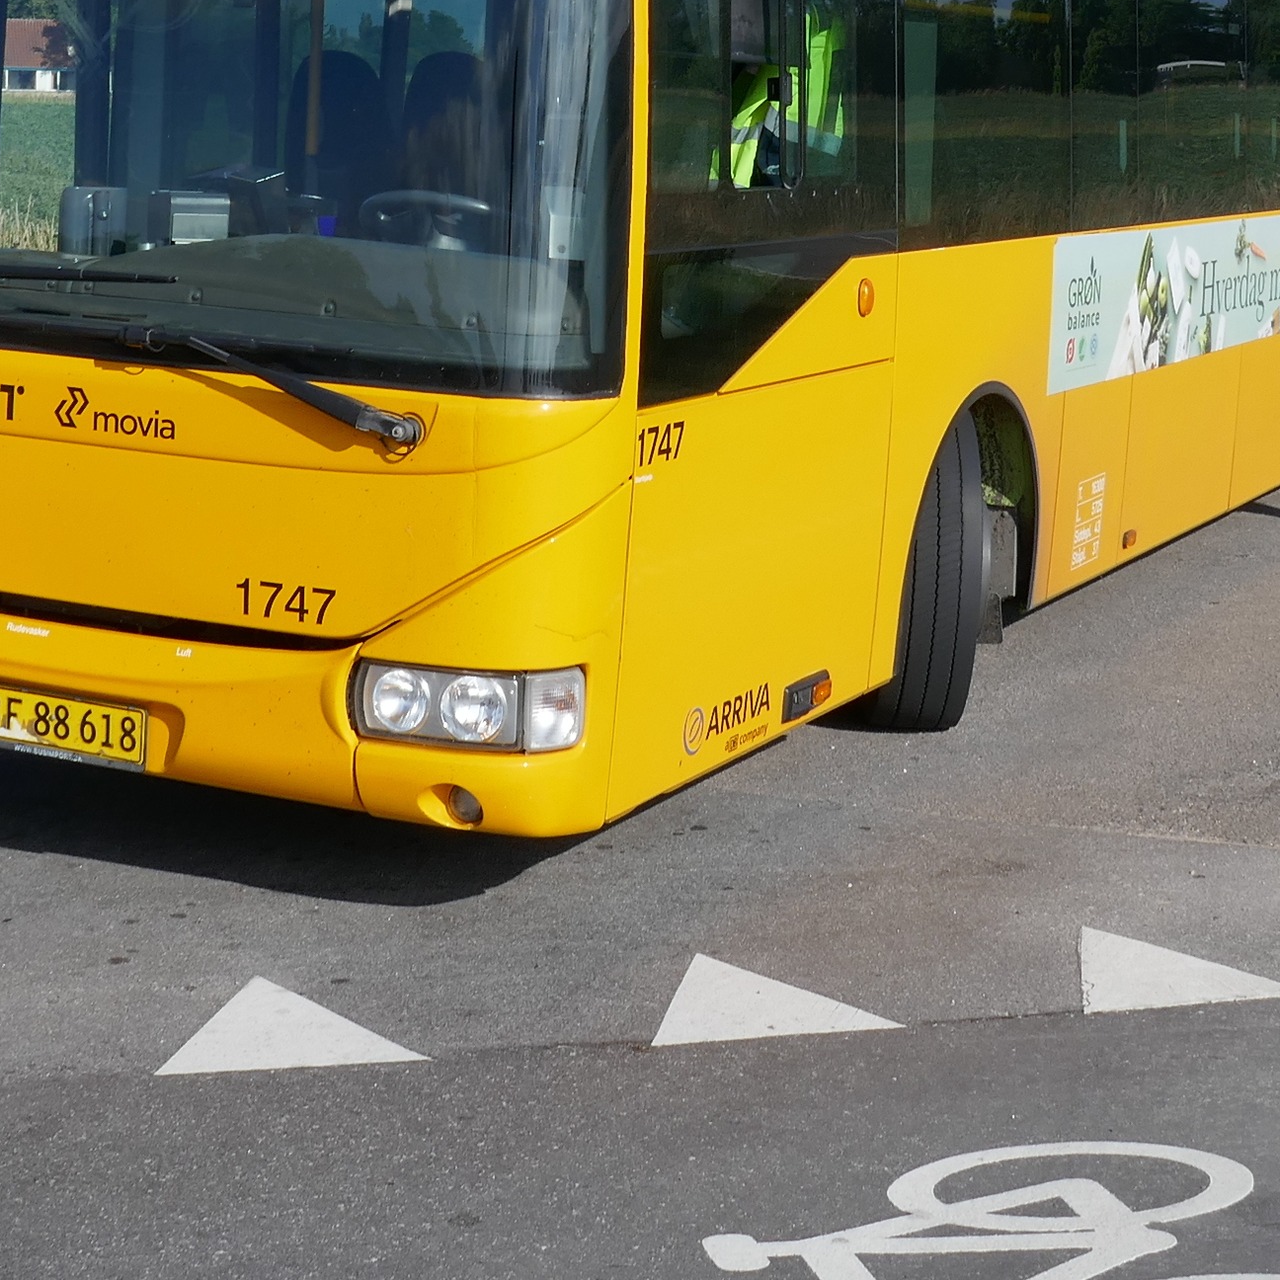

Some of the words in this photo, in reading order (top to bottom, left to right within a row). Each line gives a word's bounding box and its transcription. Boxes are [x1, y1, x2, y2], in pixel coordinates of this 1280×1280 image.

[1200, 254, 1267, 322] Hverdag
[1067, 311, 1100, 330] balance
[93, 410, 176, 440] movia
[638, 421, 685, 467] 1747
[236, 578, 336, 625] 1747
[34, 702, 69, 740] 88
[80, 709, 136, 752] 618
[706, 682, 770, 740] ARRIVA
[739, 723, 769, 745] company
